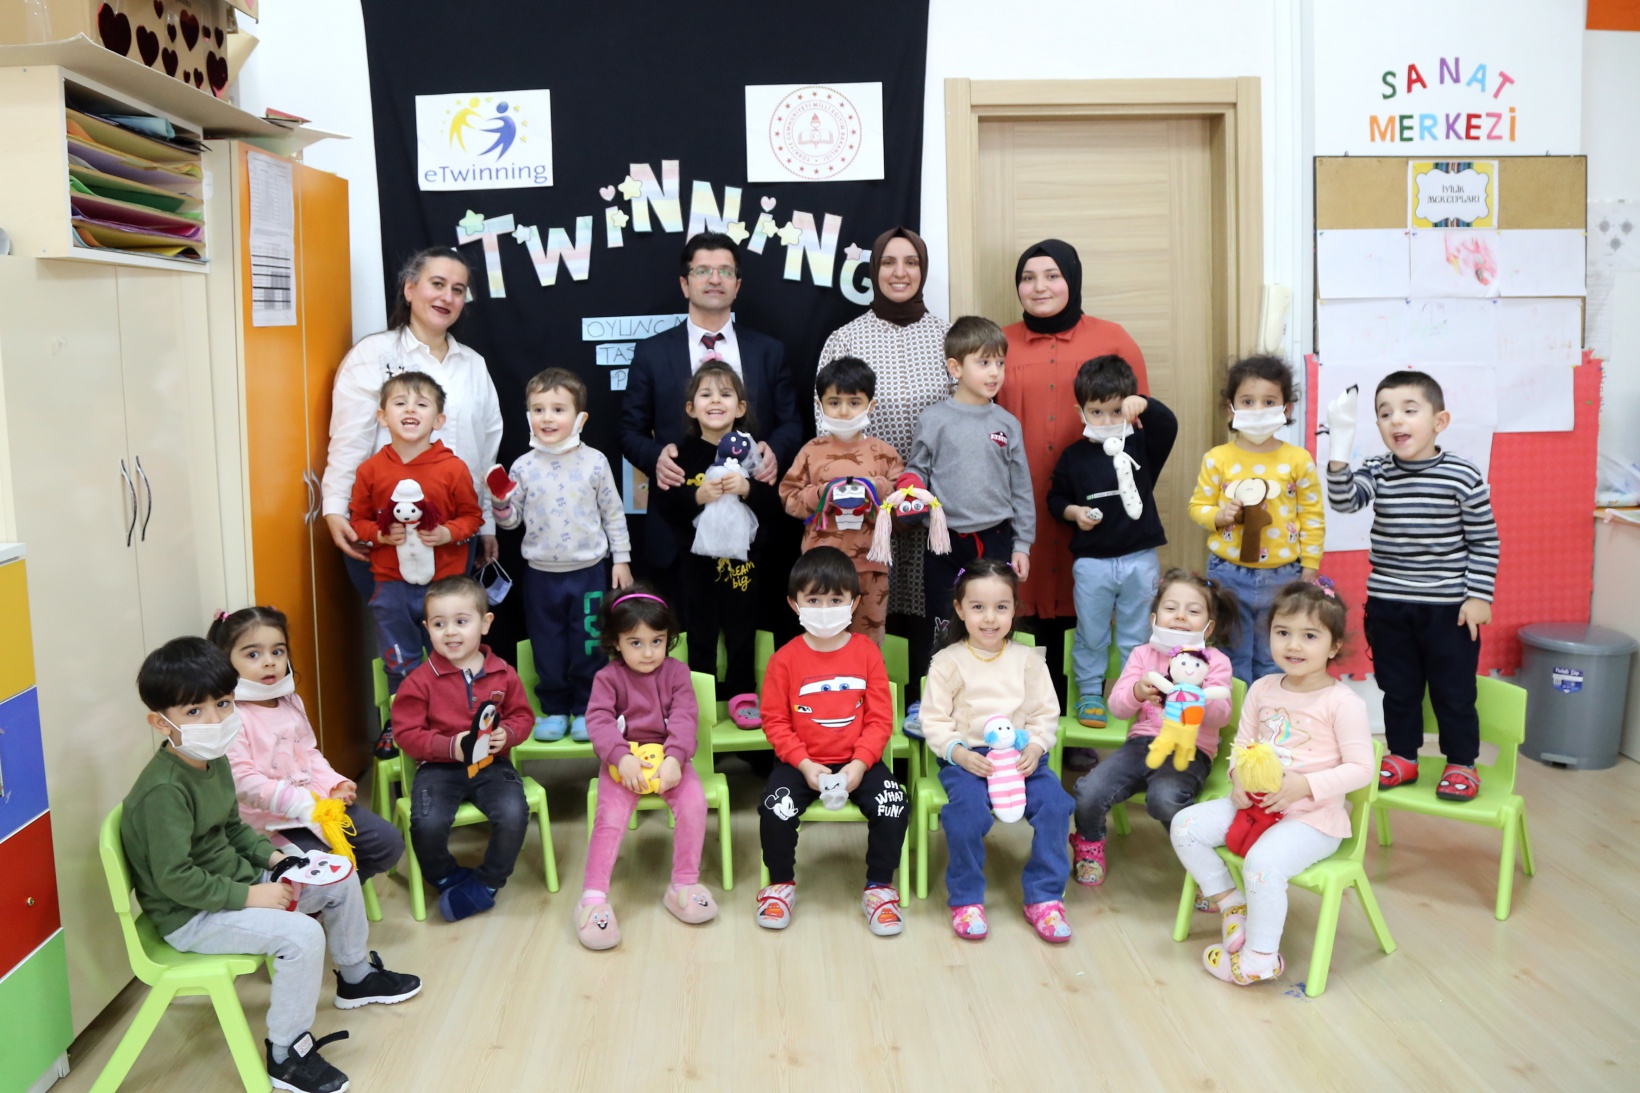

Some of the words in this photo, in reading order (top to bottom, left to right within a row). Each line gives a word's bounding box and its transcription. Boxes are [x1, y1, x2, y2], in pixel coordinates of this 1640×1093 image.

[1381, 57, 1515, 100] SANAT
[1369, 106, 1516, 143] MERKEZİ
[424, 162, 548, 184] eTwinning
[732, 576, 752, 592] big
[883, 779, 899, 790] OH
[874, 789, 904, 804] WHAT
[877, 804, 905, 818] FUN!
